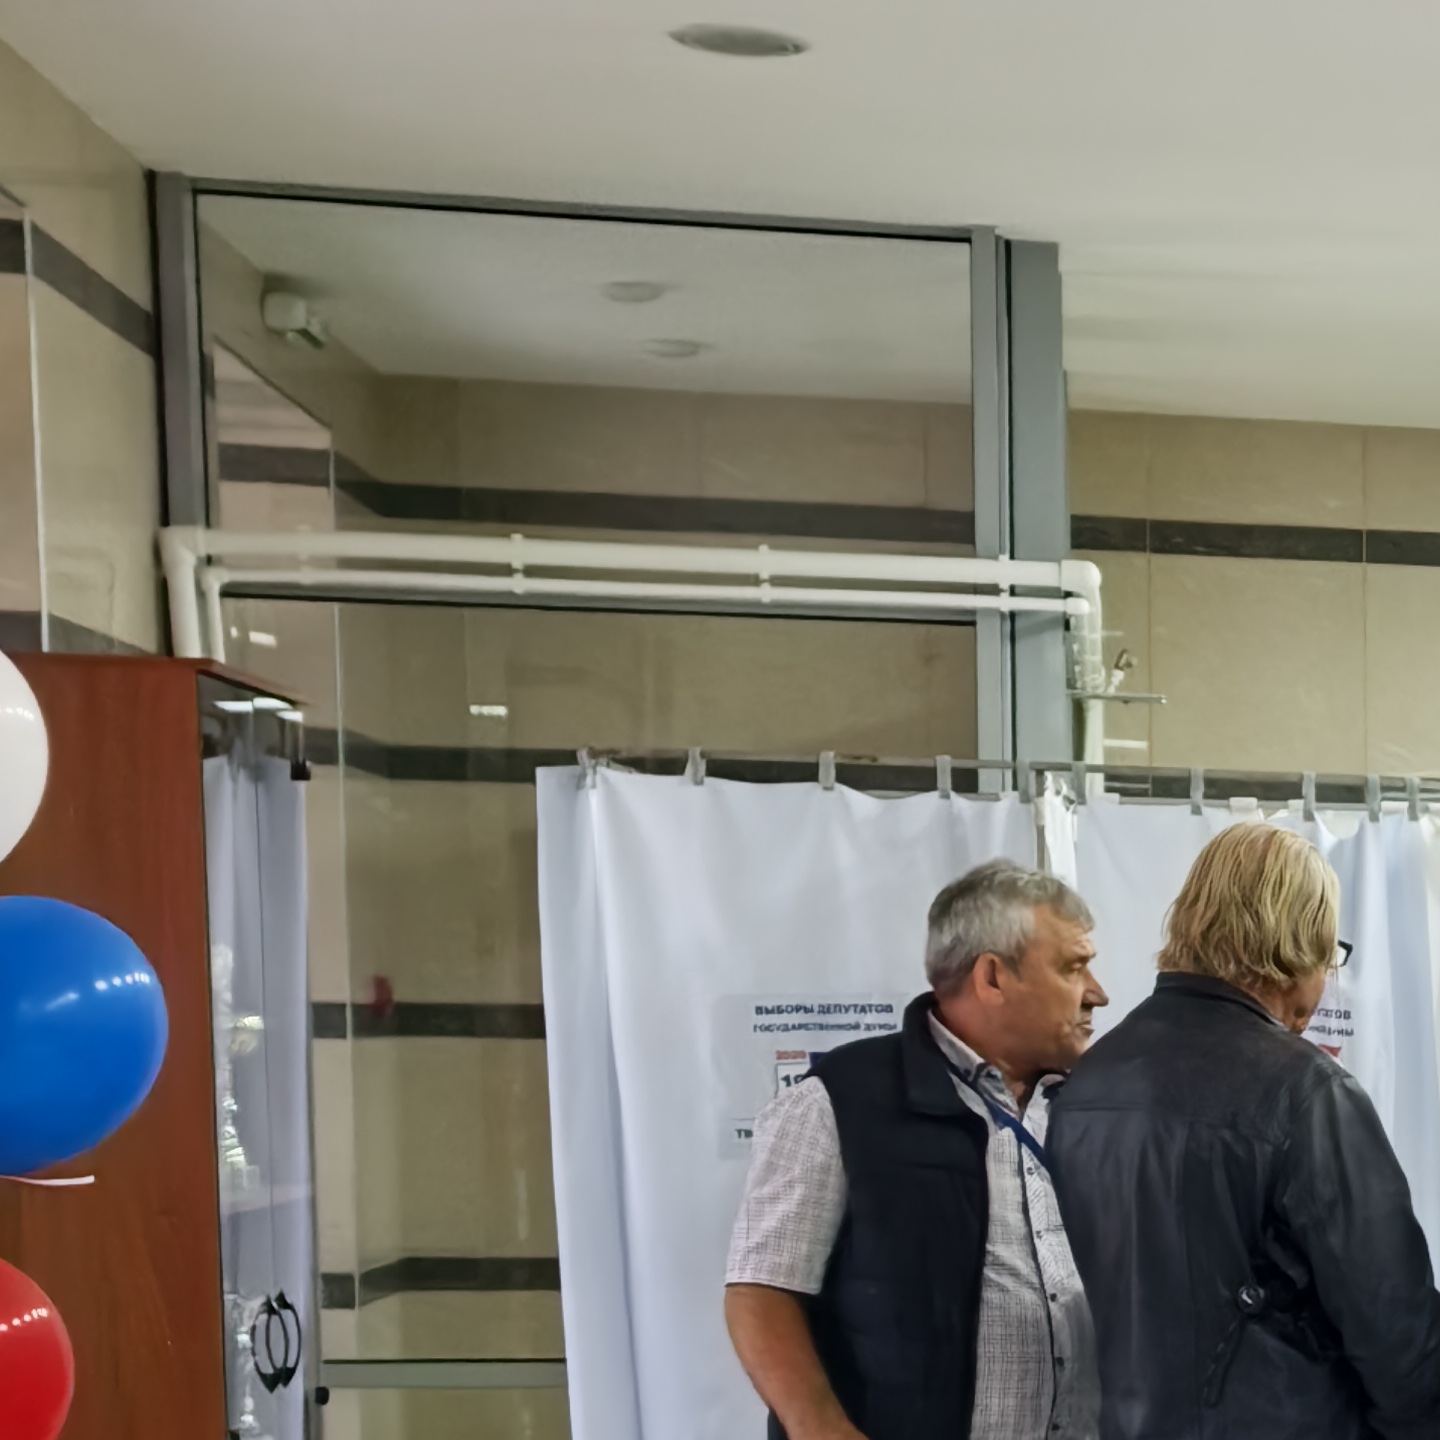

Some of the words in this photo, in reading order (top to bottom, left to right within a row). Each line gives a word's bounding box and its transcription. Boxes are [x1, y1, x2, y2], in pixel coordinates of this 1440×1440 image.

[754, 1004, 815, 1016] ВЫБОРЫ
[817, 1003, 894, 1015] ДЕПУТАТОВ
[753, 1020, 861, 1033] ГОСУДАРСТВЕННОЙ
